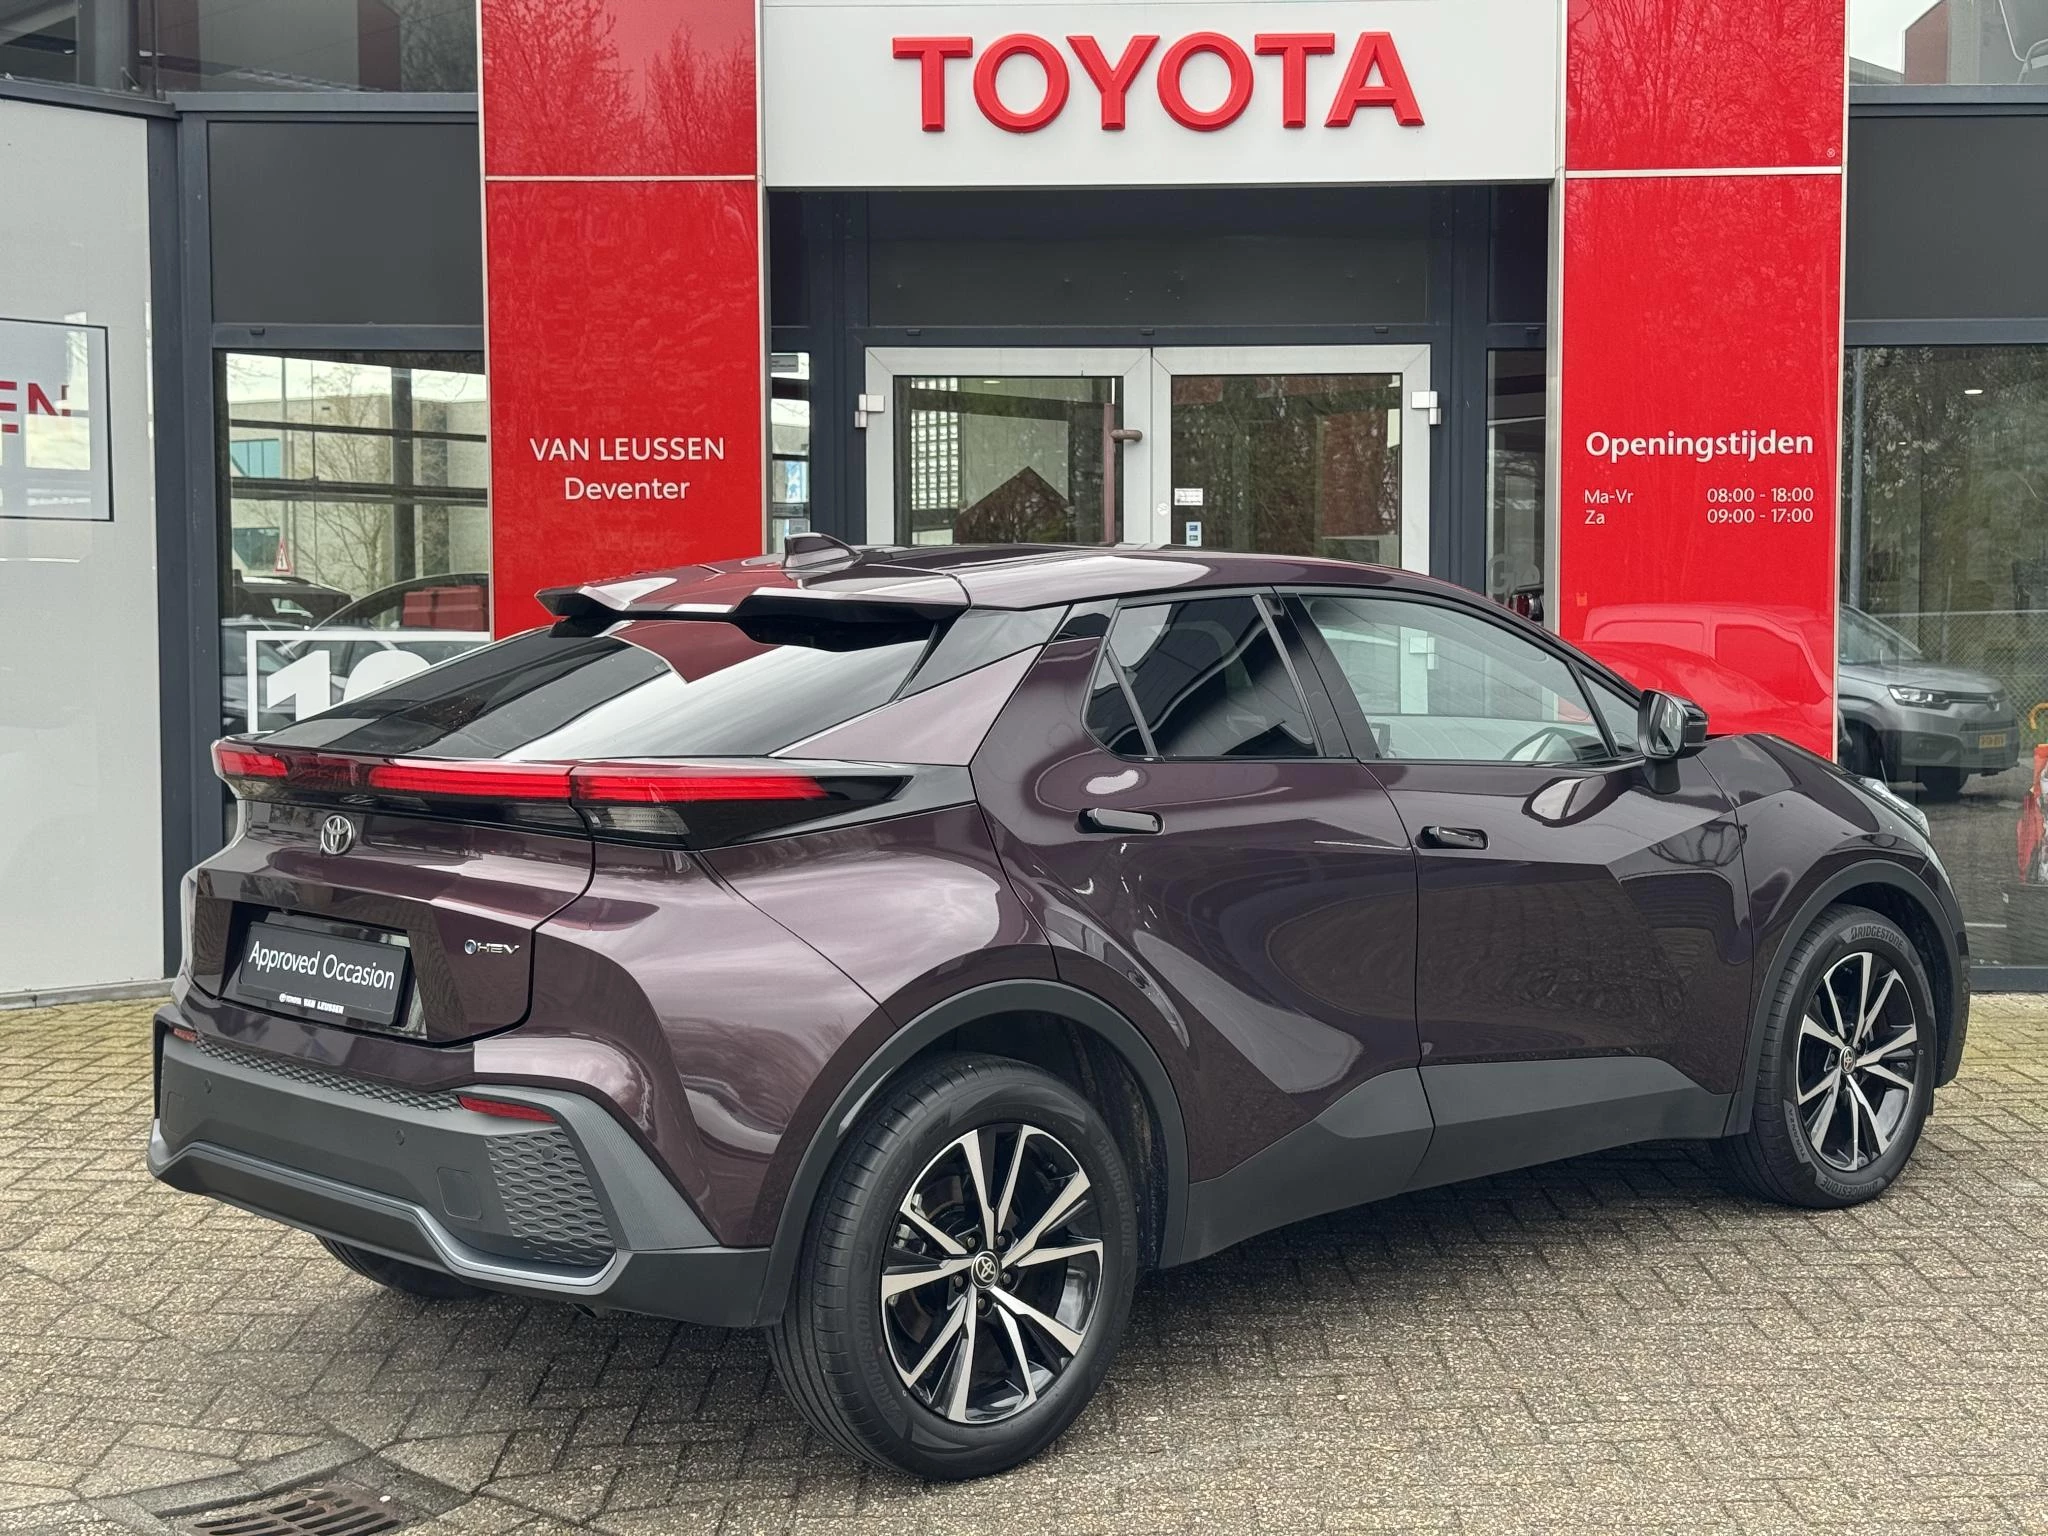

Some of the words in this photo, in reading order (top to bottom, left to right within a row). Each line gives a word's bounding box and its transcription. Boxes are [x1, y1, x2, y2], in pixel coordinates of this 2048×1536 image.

[892, 31, 1425, 133] TOYOTA
[529, 437, 590, 461] VAN
[599, 437, 725, 461] LEUSSEN
[1585, 429, 1814, 463] Openingstijden
[564, 476, 691, 500] Deventer
[1584, 489, 1634, 504] Ma-Vr
[1706, 487, 1756, 503] 08:00
[1770, 487, 1815, 503] 18:00
[1584, 509, 1606, 525] Za
[1706, 508, 1756, 524] 09:00
[1770, 508, 1815, 523] 17:00
[477, 943, 520, 954] HEV
[1850, 925, 1905, 950] BRIDGESTONE
[248, 941, 321, 975] Approved
[322, 954, 396, 990] Occasion
[316, 1000, 345, 1015] LEUSSEN
